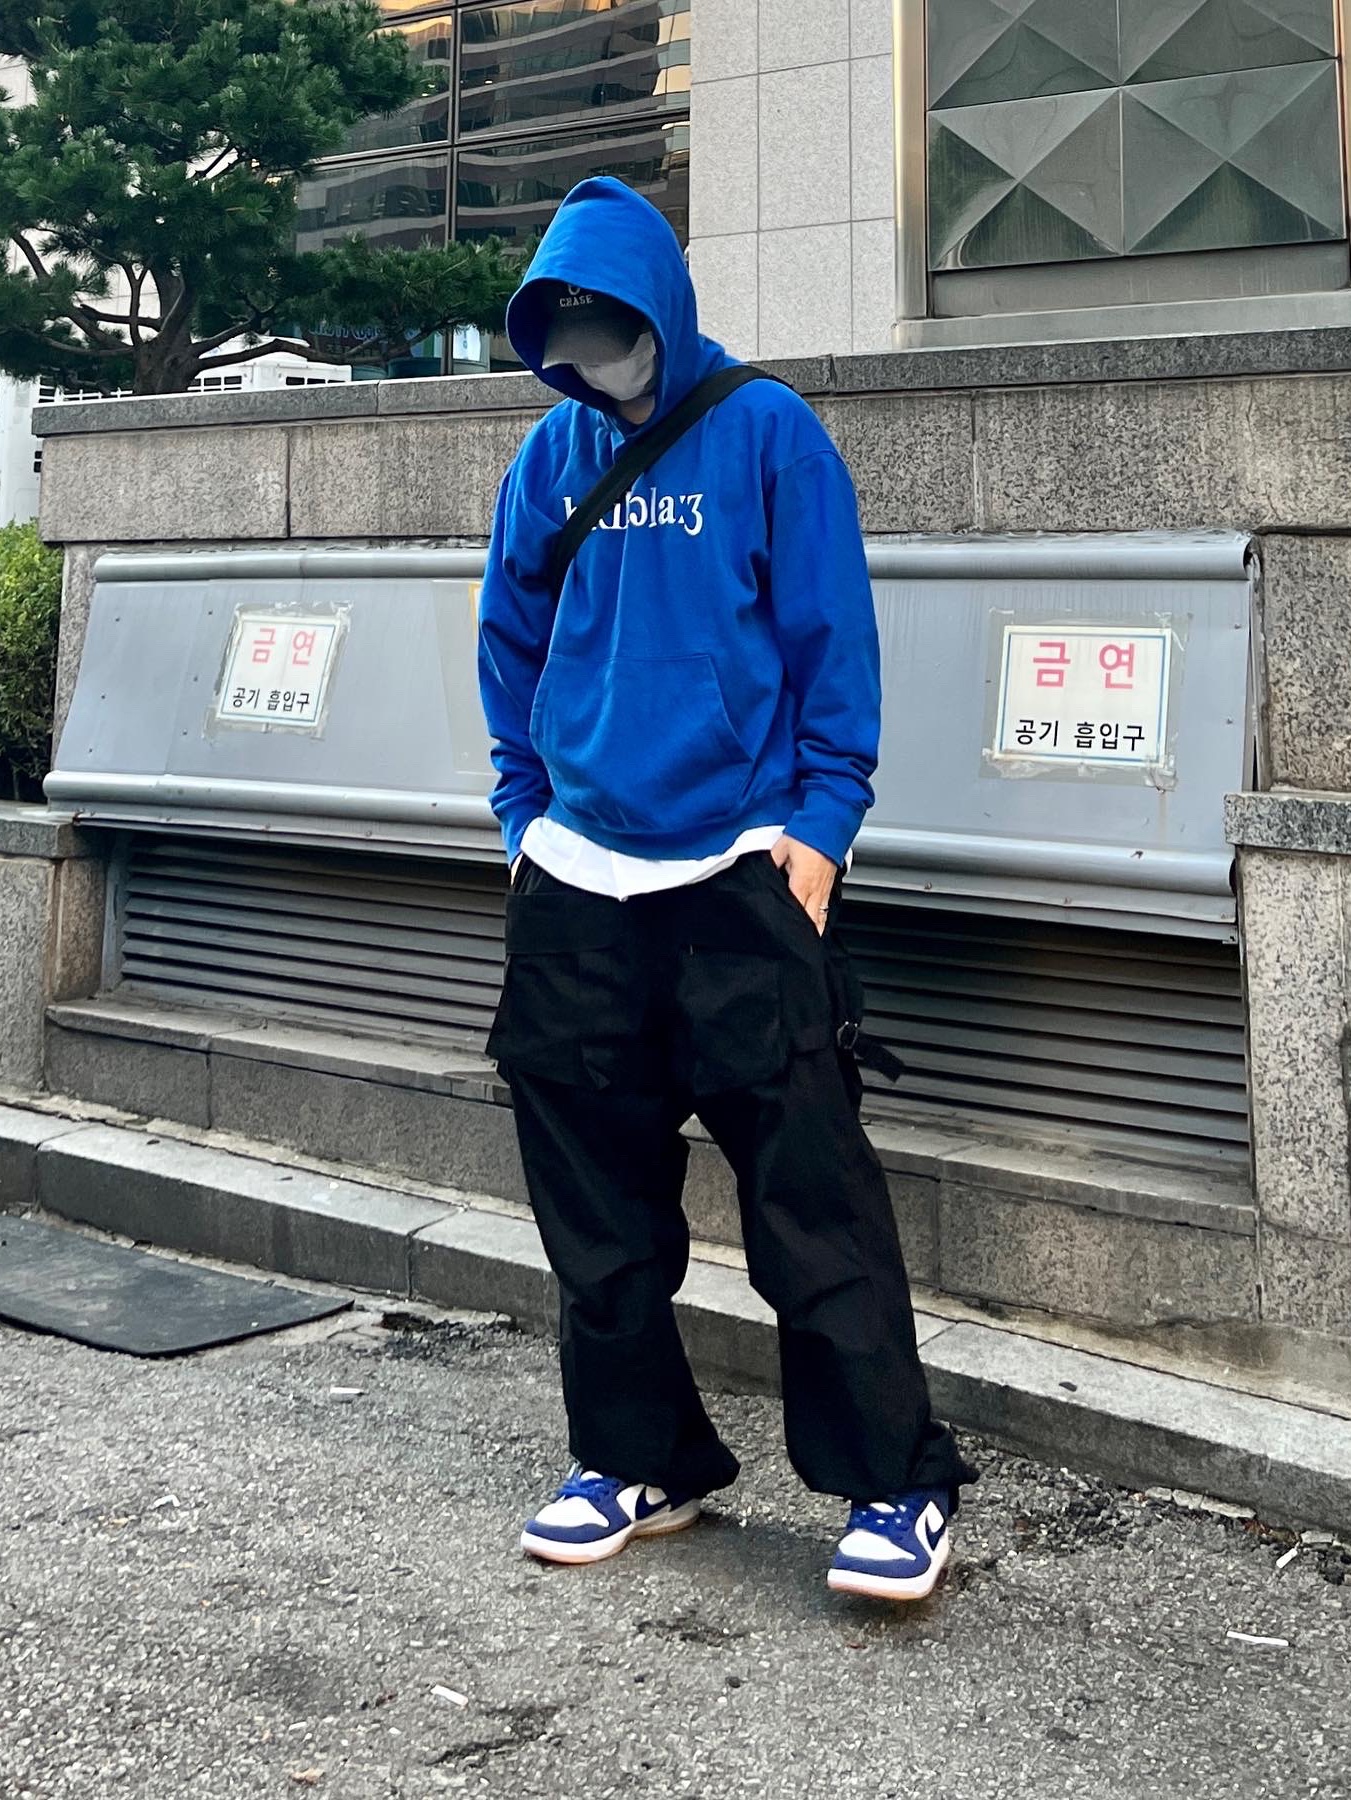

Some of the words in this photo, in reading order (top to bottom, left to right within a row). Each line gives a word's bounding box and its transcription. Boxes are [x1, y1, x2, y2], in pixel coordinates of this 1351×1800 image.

[232, 687, 261, 710] 공기
[267, 689, 311, 713] 흡입구
[1015, 718, 1059, 748] 공기
[1073, 720, 1146, 752] 흡입구
